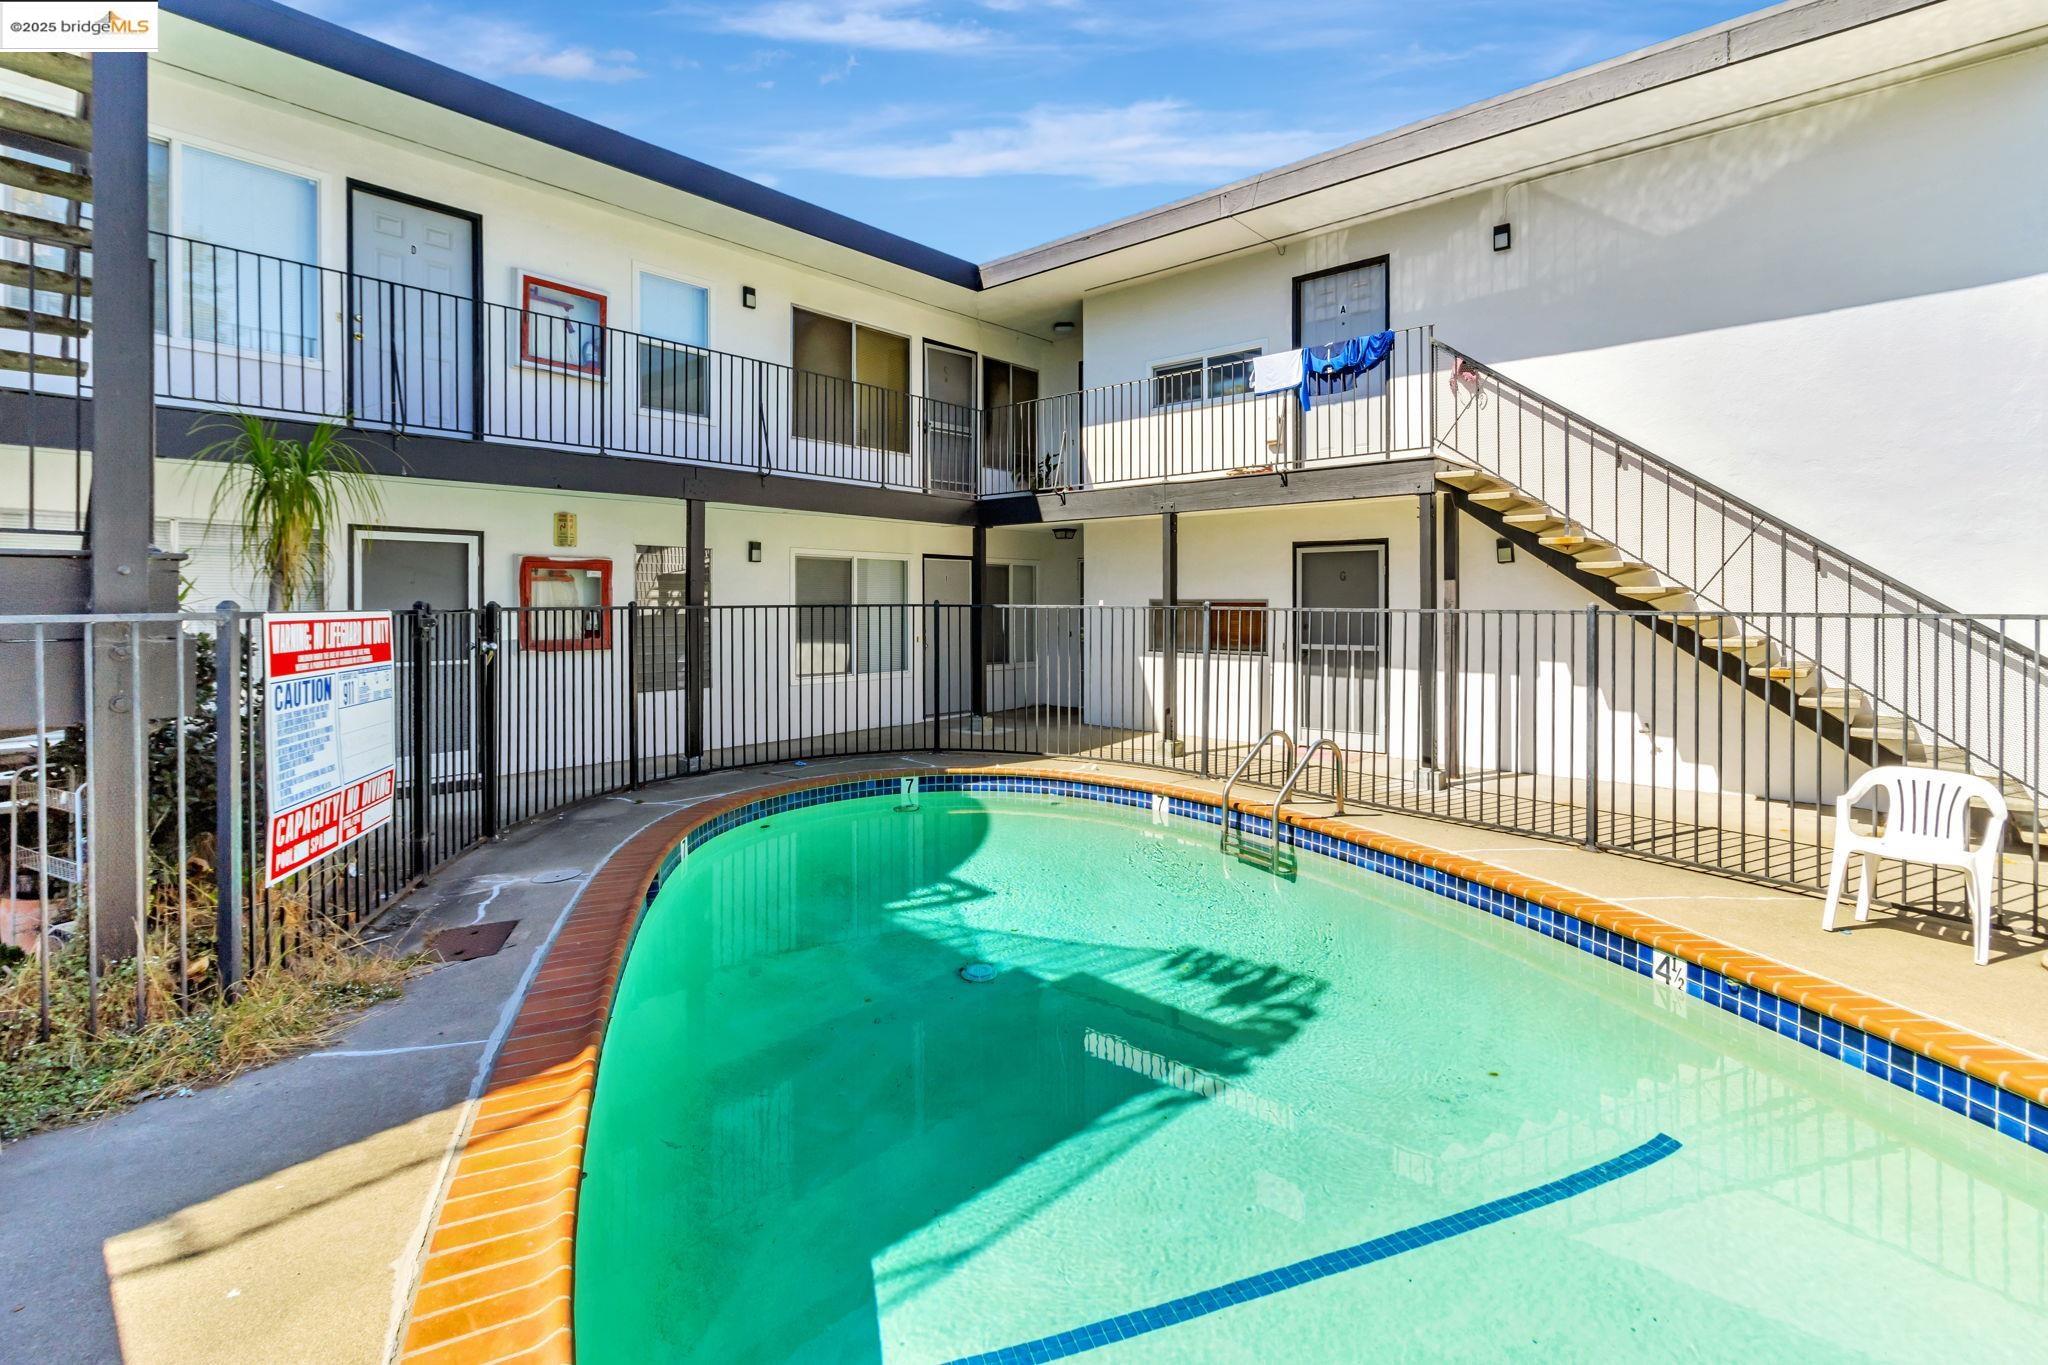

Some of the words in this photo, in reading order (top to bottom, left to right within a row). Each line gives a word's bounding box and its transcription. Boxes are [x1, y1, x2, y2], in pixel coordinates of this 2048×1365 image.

[1340, 305, 1346, 314] A
[313, 622, 325, 650] NO
[372, 619, 389, 645] DUTY
[275, 676, 332, 711] CAUTION
[344, 681, 354, 705] 911
[346, 786, 360, 815] NO
[361, 772, 392, 807] DIVING
[905, 778, 914, 794] 7
[1157, 794, 1164, 812] 7
[275, 794, 341, 847] CAPACITY
[310, 834, 324, 854] SPA
